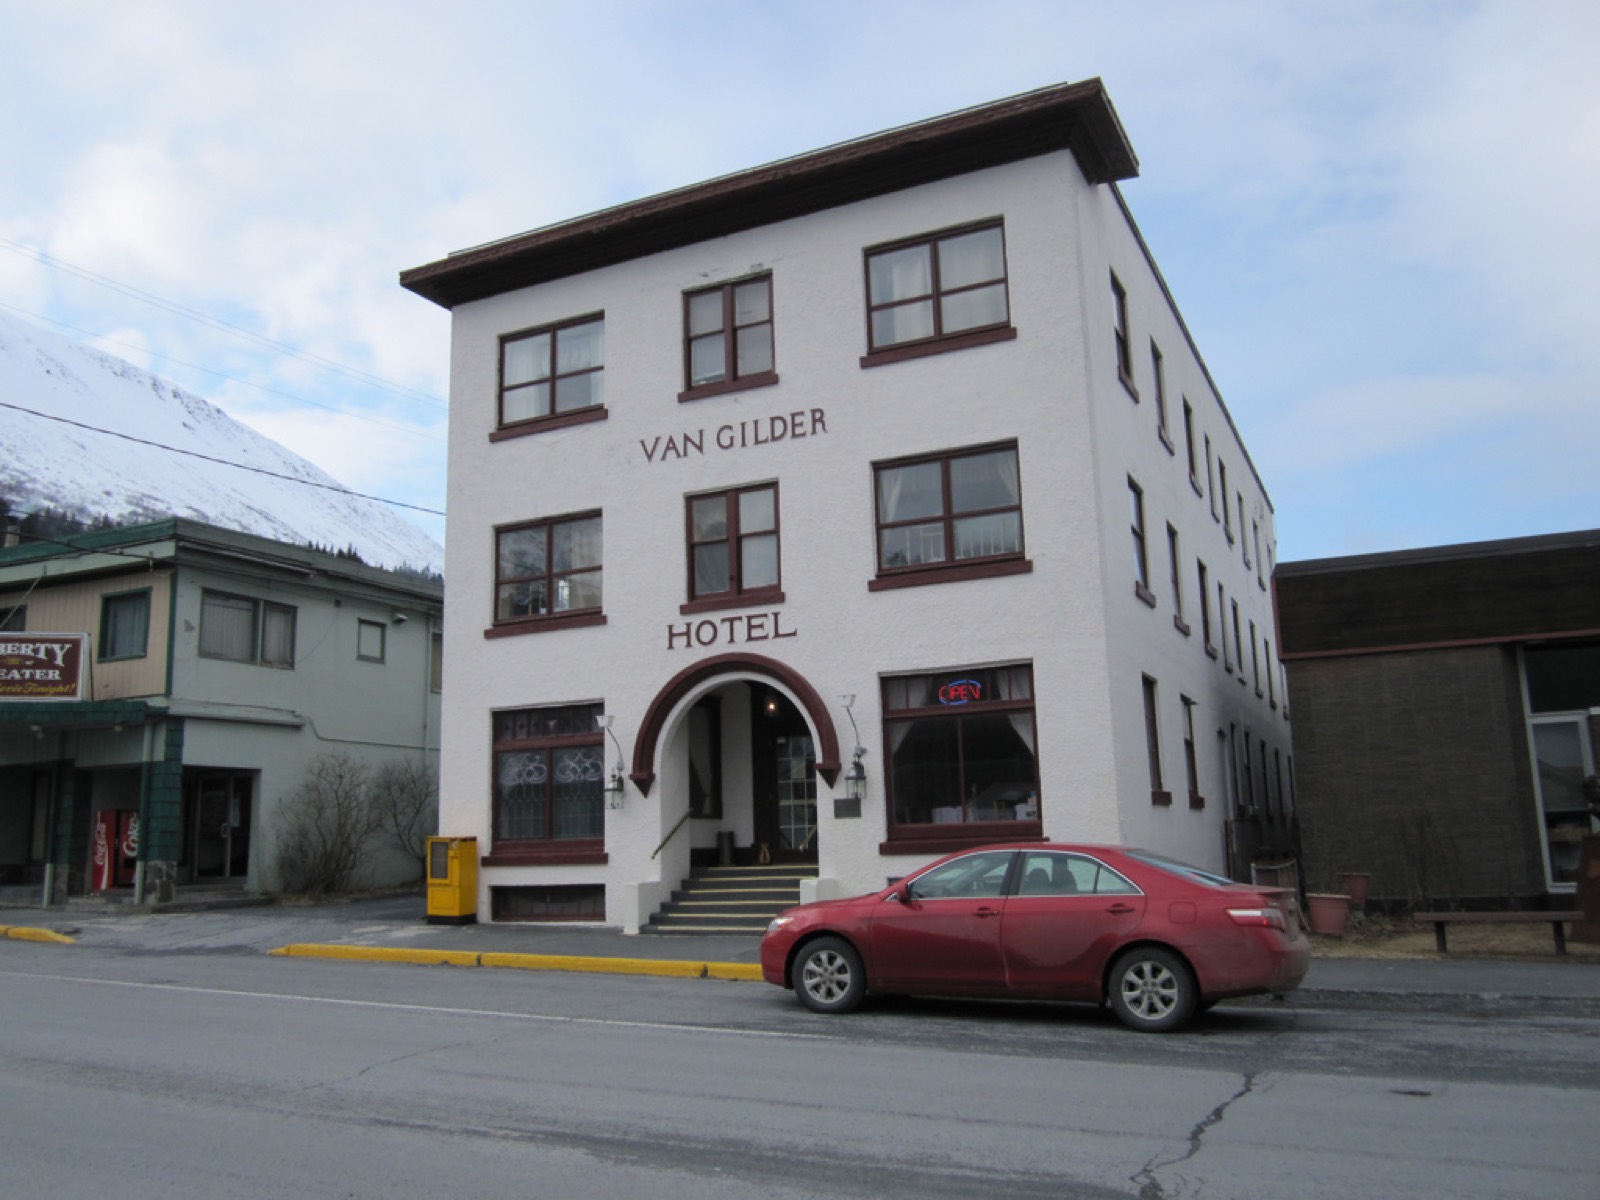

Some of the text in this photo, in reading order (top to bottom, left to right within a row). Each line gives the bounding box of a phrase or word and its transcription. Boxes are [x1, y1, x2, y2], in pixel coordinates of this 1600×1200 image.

[640, 408, 828, 463] VAN GILDER
[667, 611, 798, 650] HOTEL
[938, 685, 981, 700] OPEN
